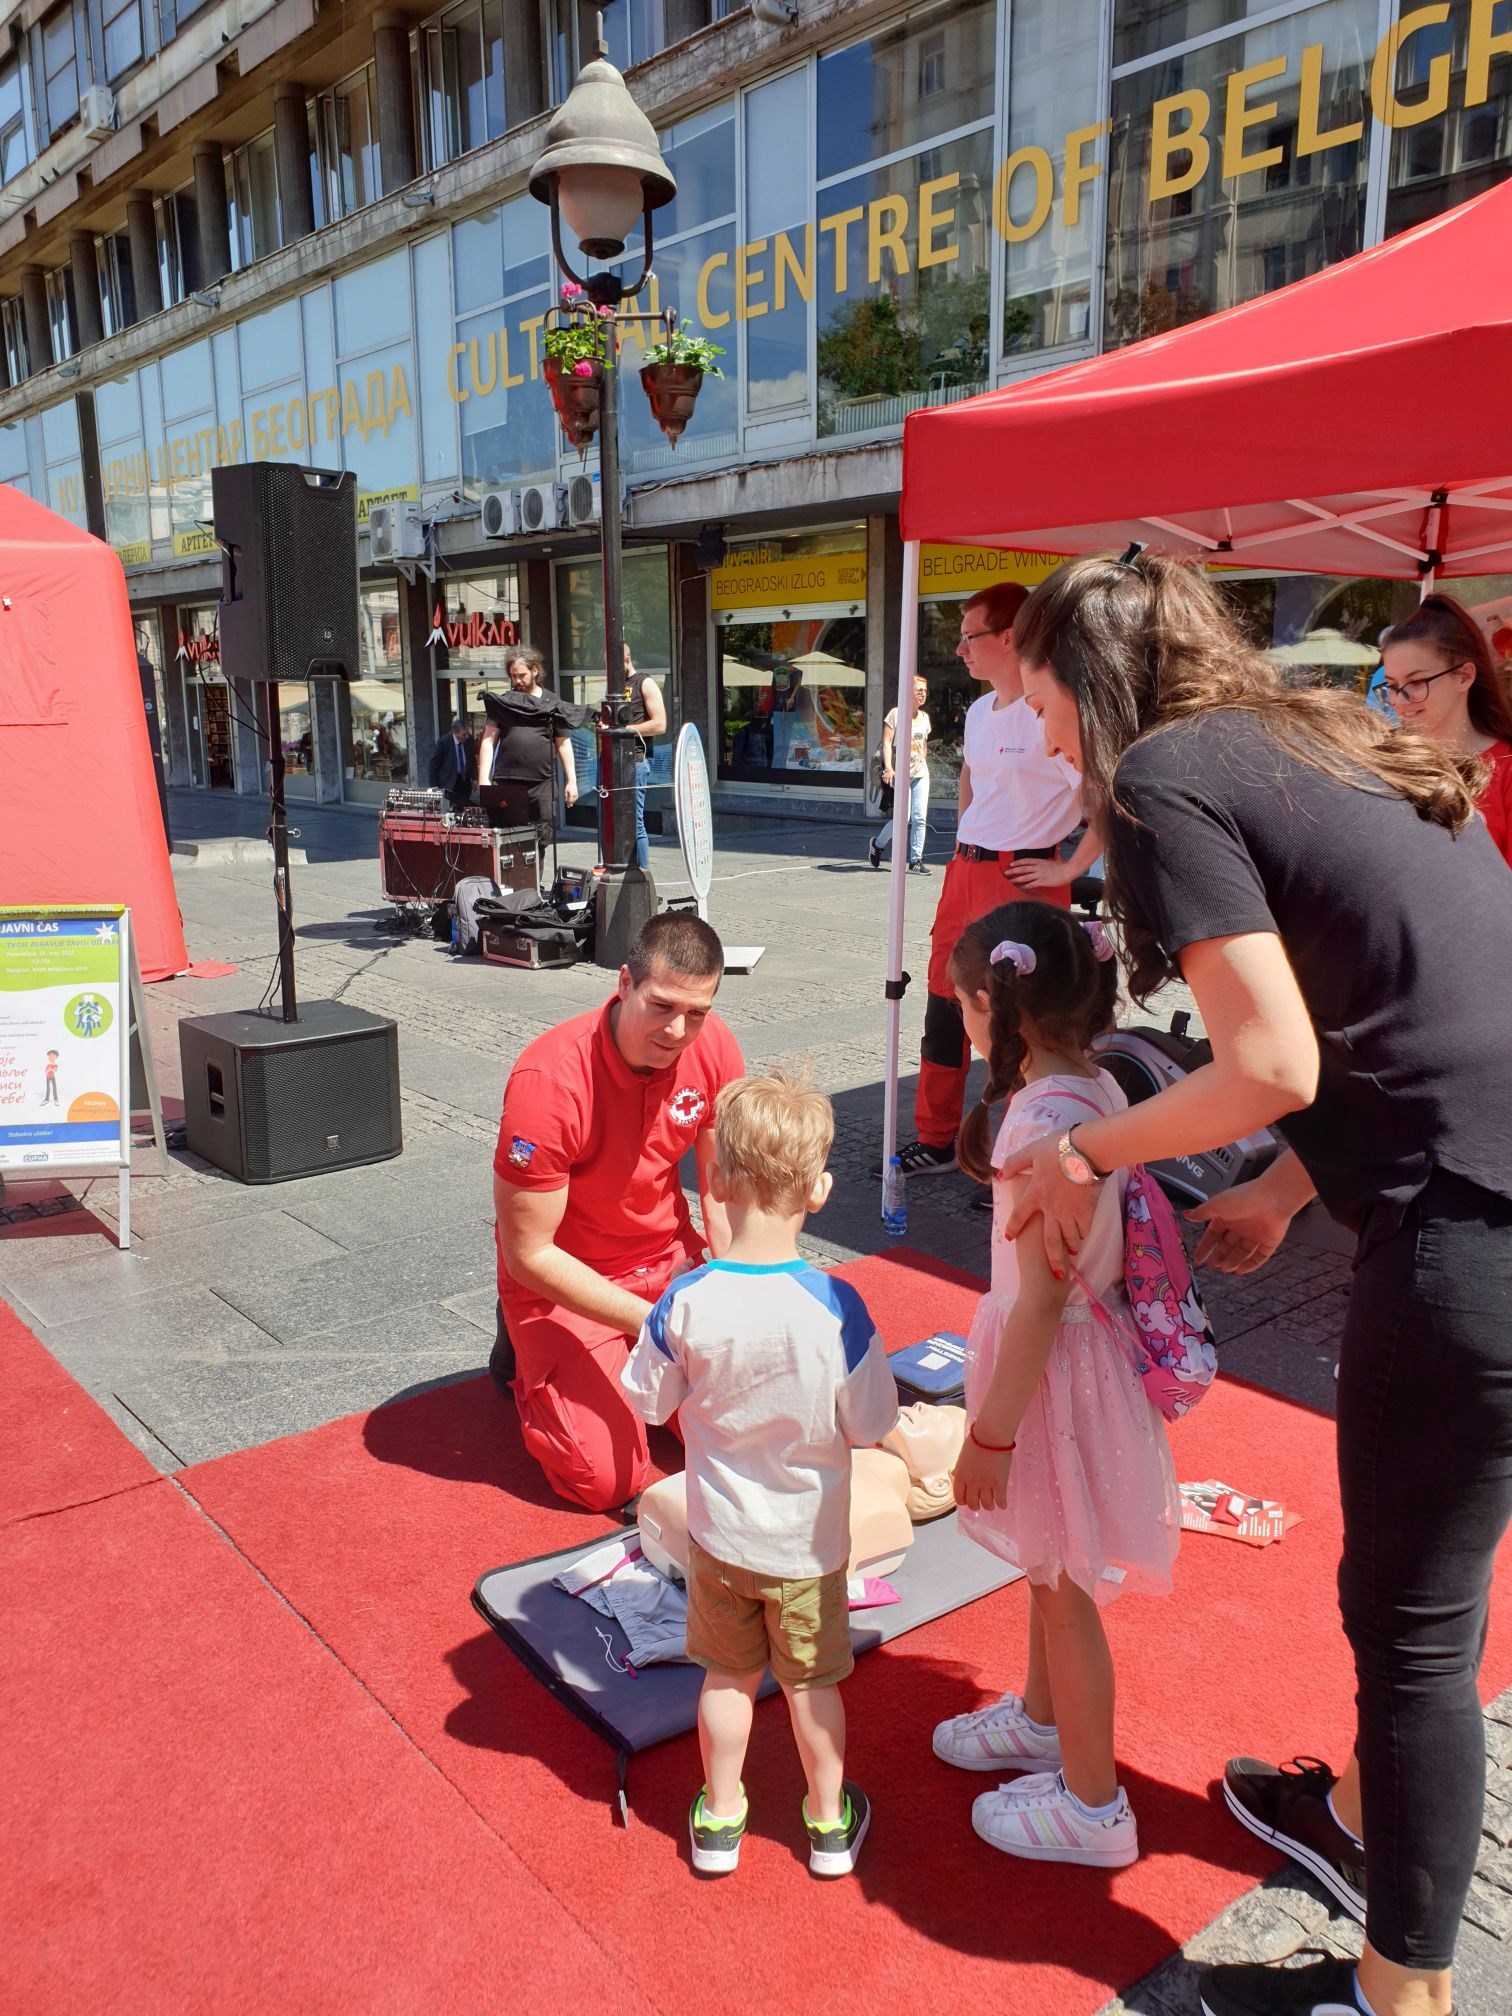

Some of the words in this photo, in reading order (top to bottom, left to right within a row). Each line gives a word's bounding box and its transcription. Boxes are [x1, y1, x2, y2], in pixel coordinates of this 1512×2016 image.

[697, 172, 961, 330] CENTRE
[993, 118, 1112, 243] OF
[157, 419, 243, 496] ЦЕНТАР
[251, 364, 412, 460] БЕОГРАДА
[922, 552, 1009, 577] BELGRADE
[716, 575, 788, 596] BEOGRADSKI
[791, 570, 826, 590] IZLOG
[1, 923, 34, 933] JAVNI
[37, 920, 59, 932] ČAS
